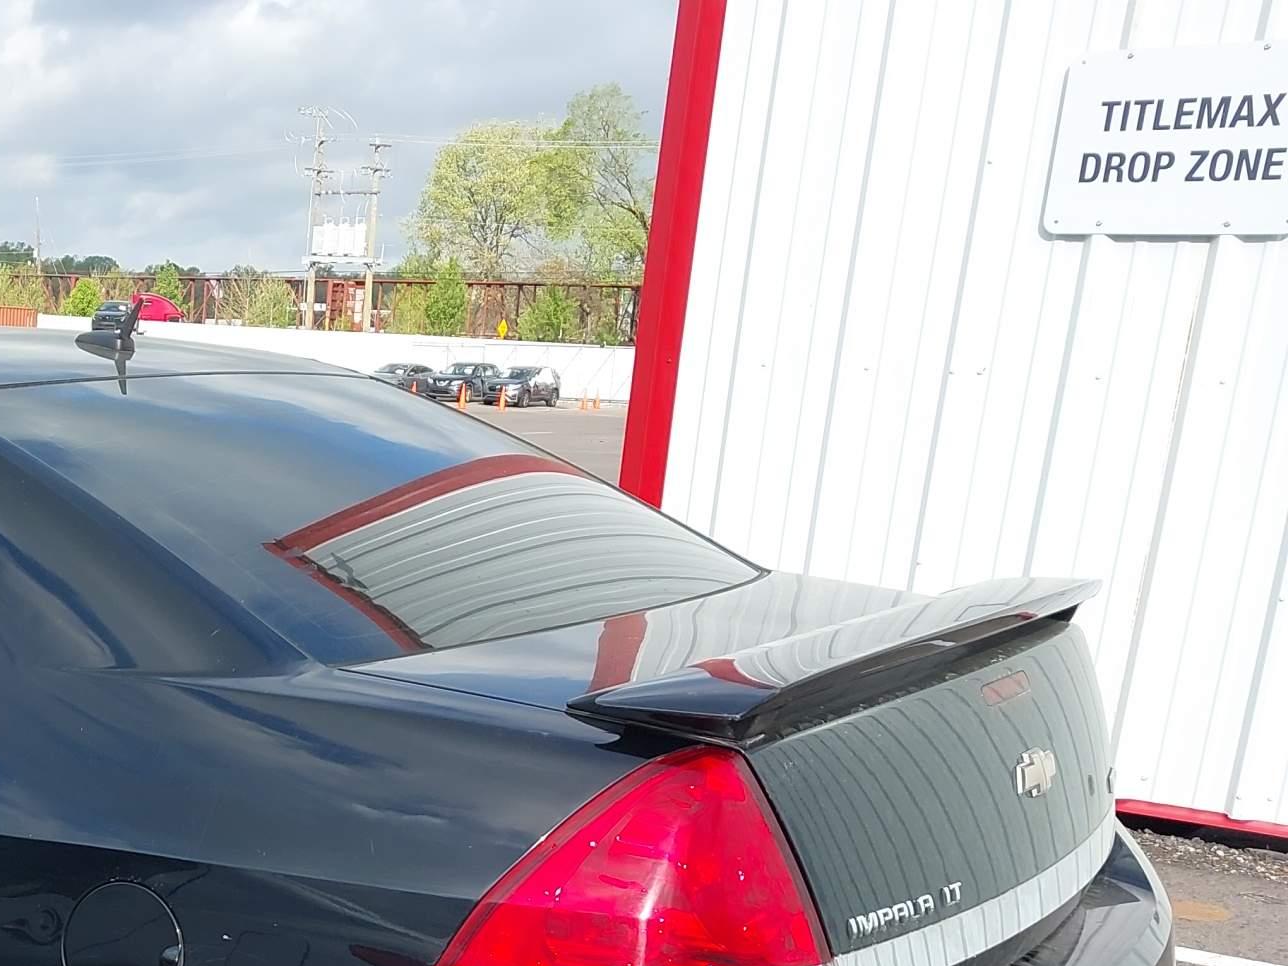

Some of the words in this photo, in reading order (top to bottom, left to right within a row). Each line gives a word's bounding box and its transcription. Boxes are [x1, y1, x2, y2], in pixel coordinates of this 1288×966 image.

[1101, 92, 1287, 132] TITLEMAX
[1078, 151, 1176, 183] DROP
[1184, 147, 1288, 182] ZONE
[847, 894, 935, 940] IMPALA
